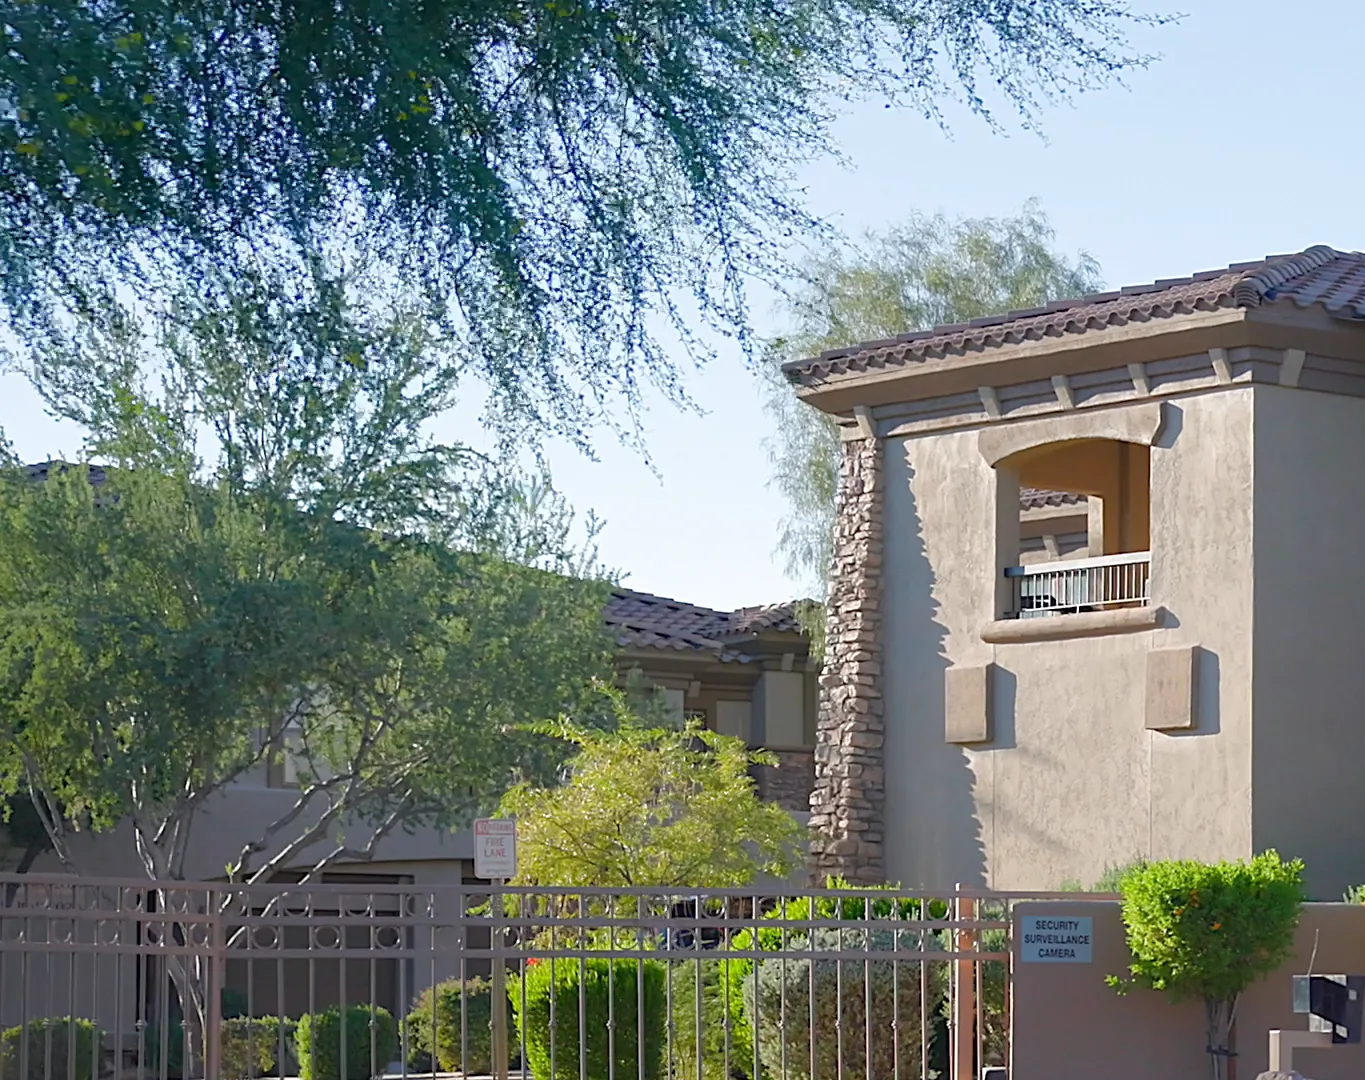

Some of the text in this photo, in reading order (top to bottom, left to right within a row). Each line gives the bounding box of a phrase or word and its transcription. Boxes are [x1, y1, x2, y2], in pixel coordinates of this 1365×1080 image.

[486, 837, 504, 847] FIRE
[484, 848, 507, 857] LANE
[1035, 920, 1079, 930] SECURITY
[1024, 934, 1090, 945] SURVEILLANCE
[1038, 948, 1076, 958] CAMERA
